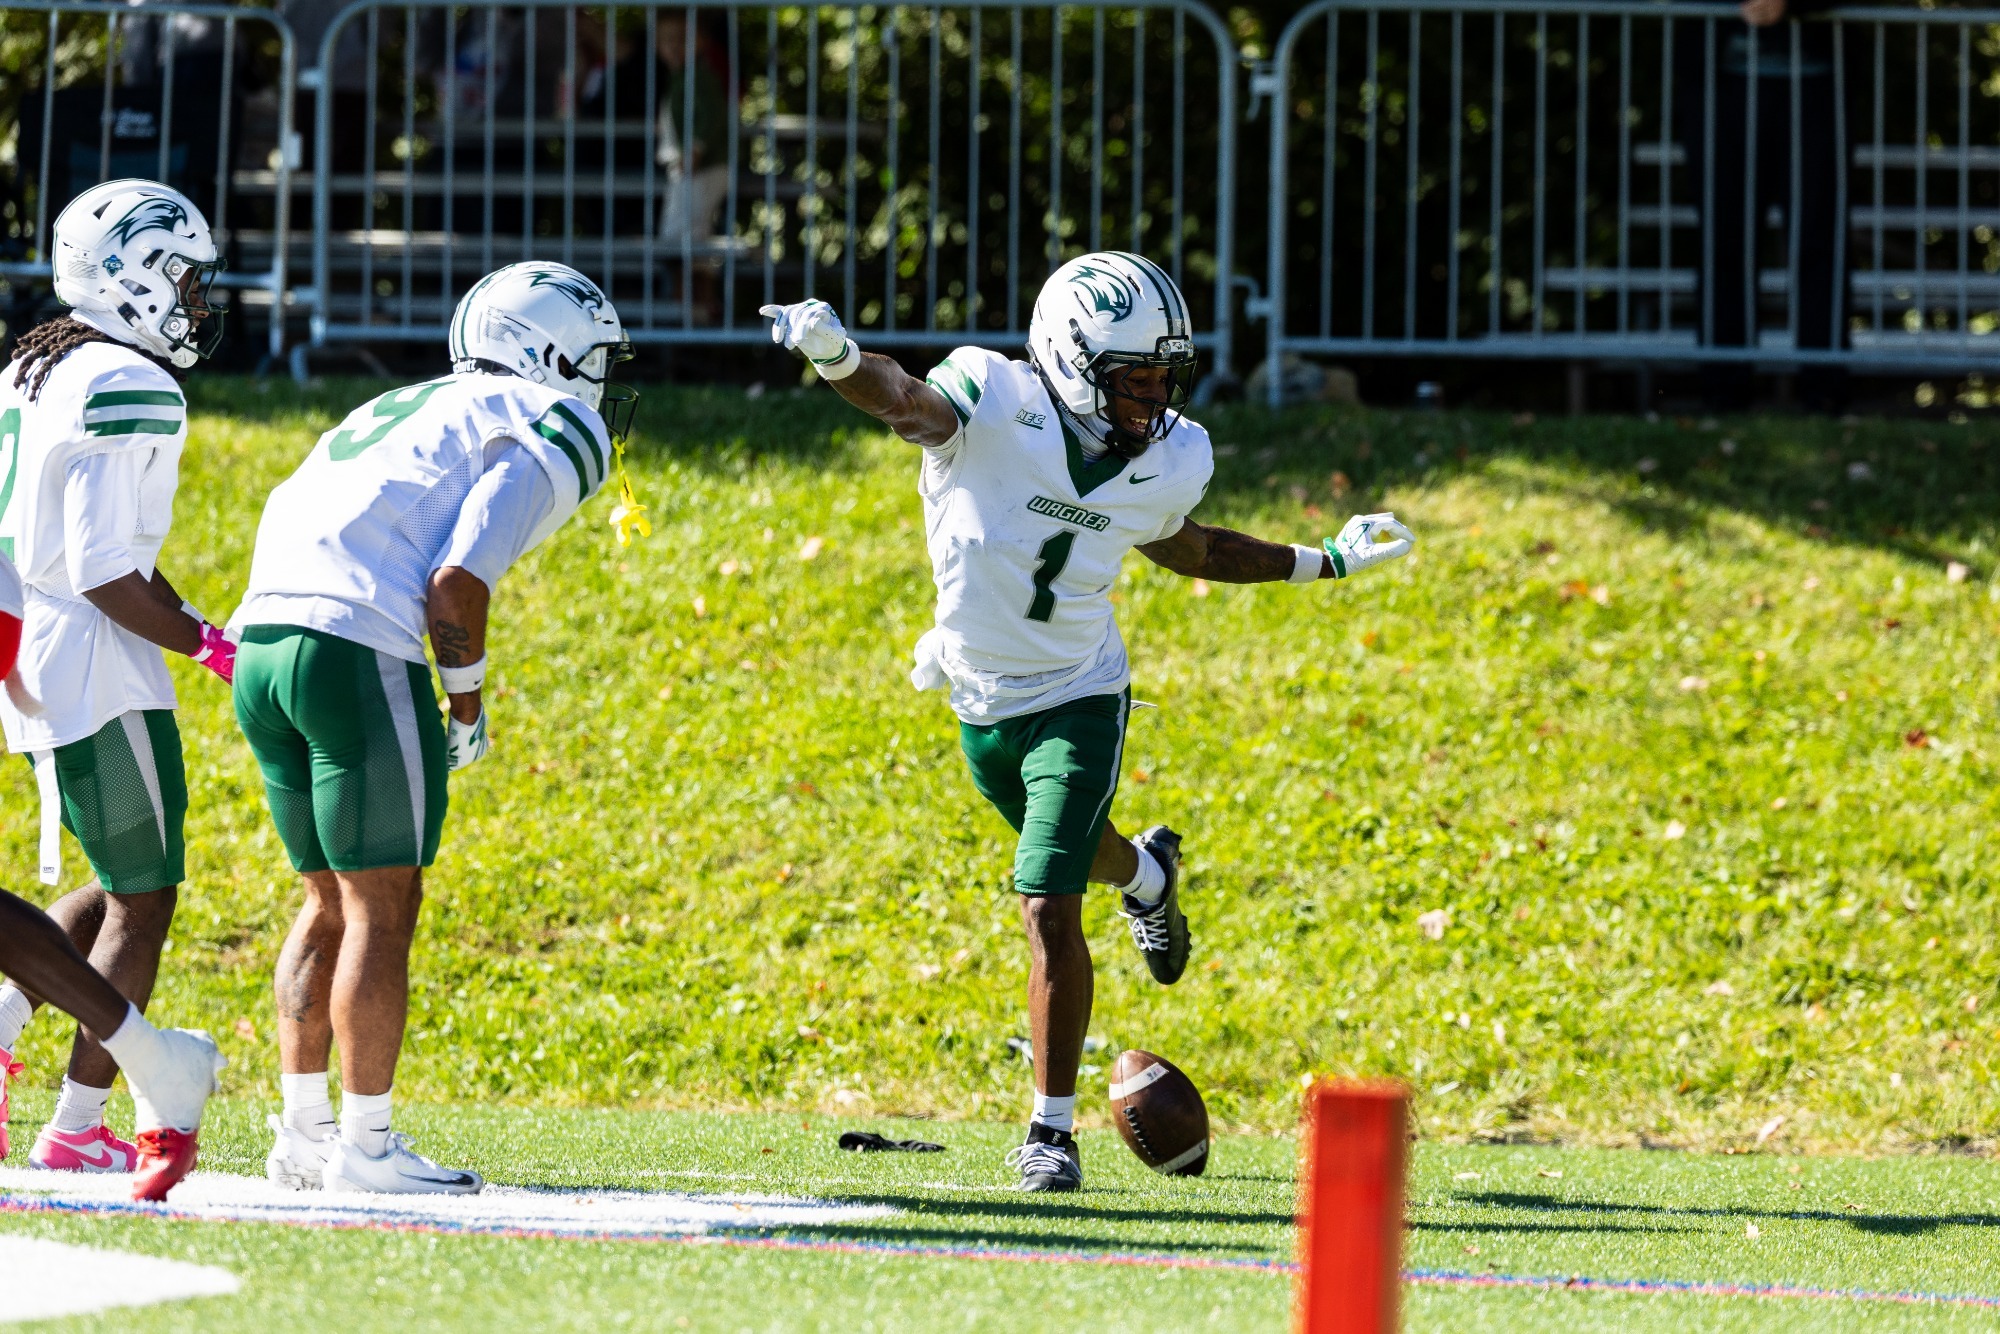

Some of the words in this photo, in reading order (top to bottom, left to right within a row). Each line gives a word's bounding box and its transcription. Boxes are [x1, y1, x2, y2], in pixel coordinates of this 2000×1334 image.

[328, 380, 457, 461] 9
[1015, 408, 1047, 426] NEC
[1028, 496, 1110, 531] WAGNER
[1024, 528, 1079, 622] 1
